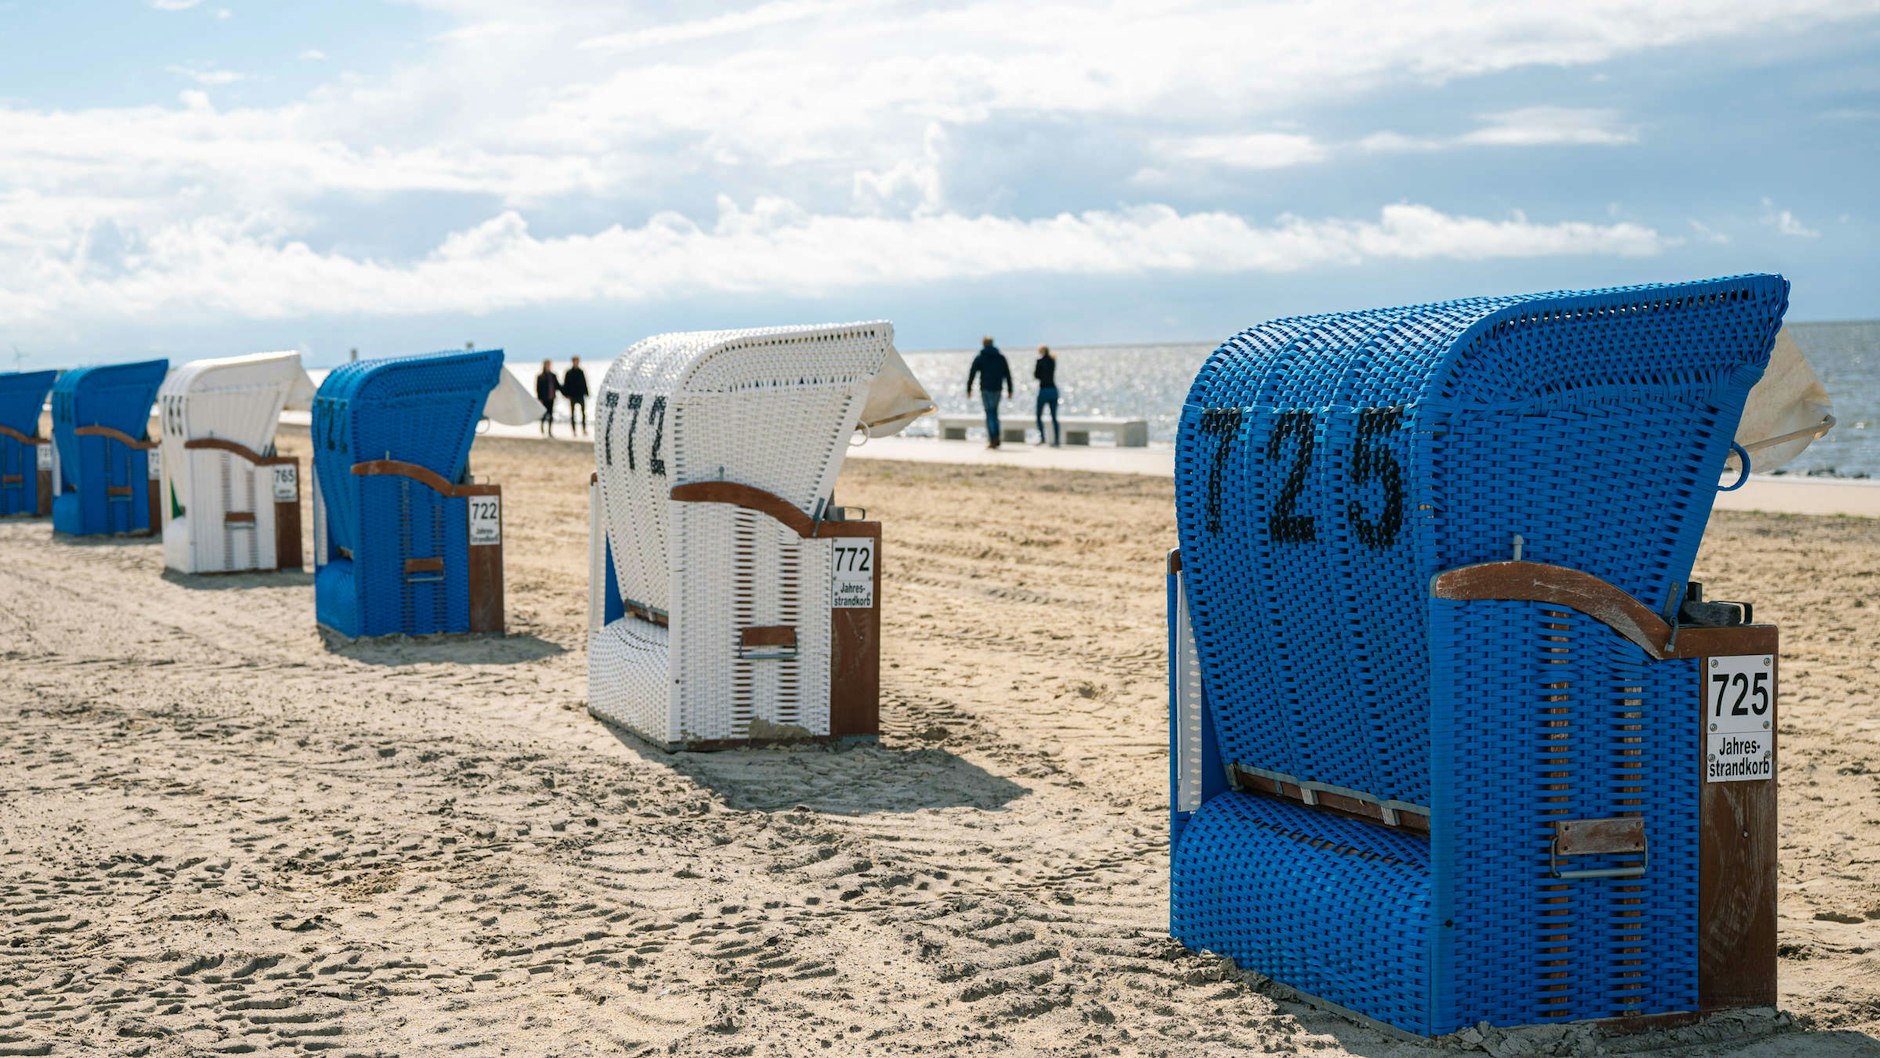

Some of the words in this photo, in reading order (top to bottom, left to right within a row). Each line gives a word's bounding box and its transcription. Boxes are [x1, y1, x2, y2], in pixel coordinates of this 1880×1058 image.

[605, 392, 666, 477] 772
[1200, 407, 1403, 549] 725
[472, 502, 497, 520] 722
[835, 547, 870, 572] 772
[840, 582, 866, 594] Jahres-
[1712, 672, 1769, 717] 725
[1719, 737, 1761, 756] Jahres-
[1709, 757, 1770, 778] strandkorb
